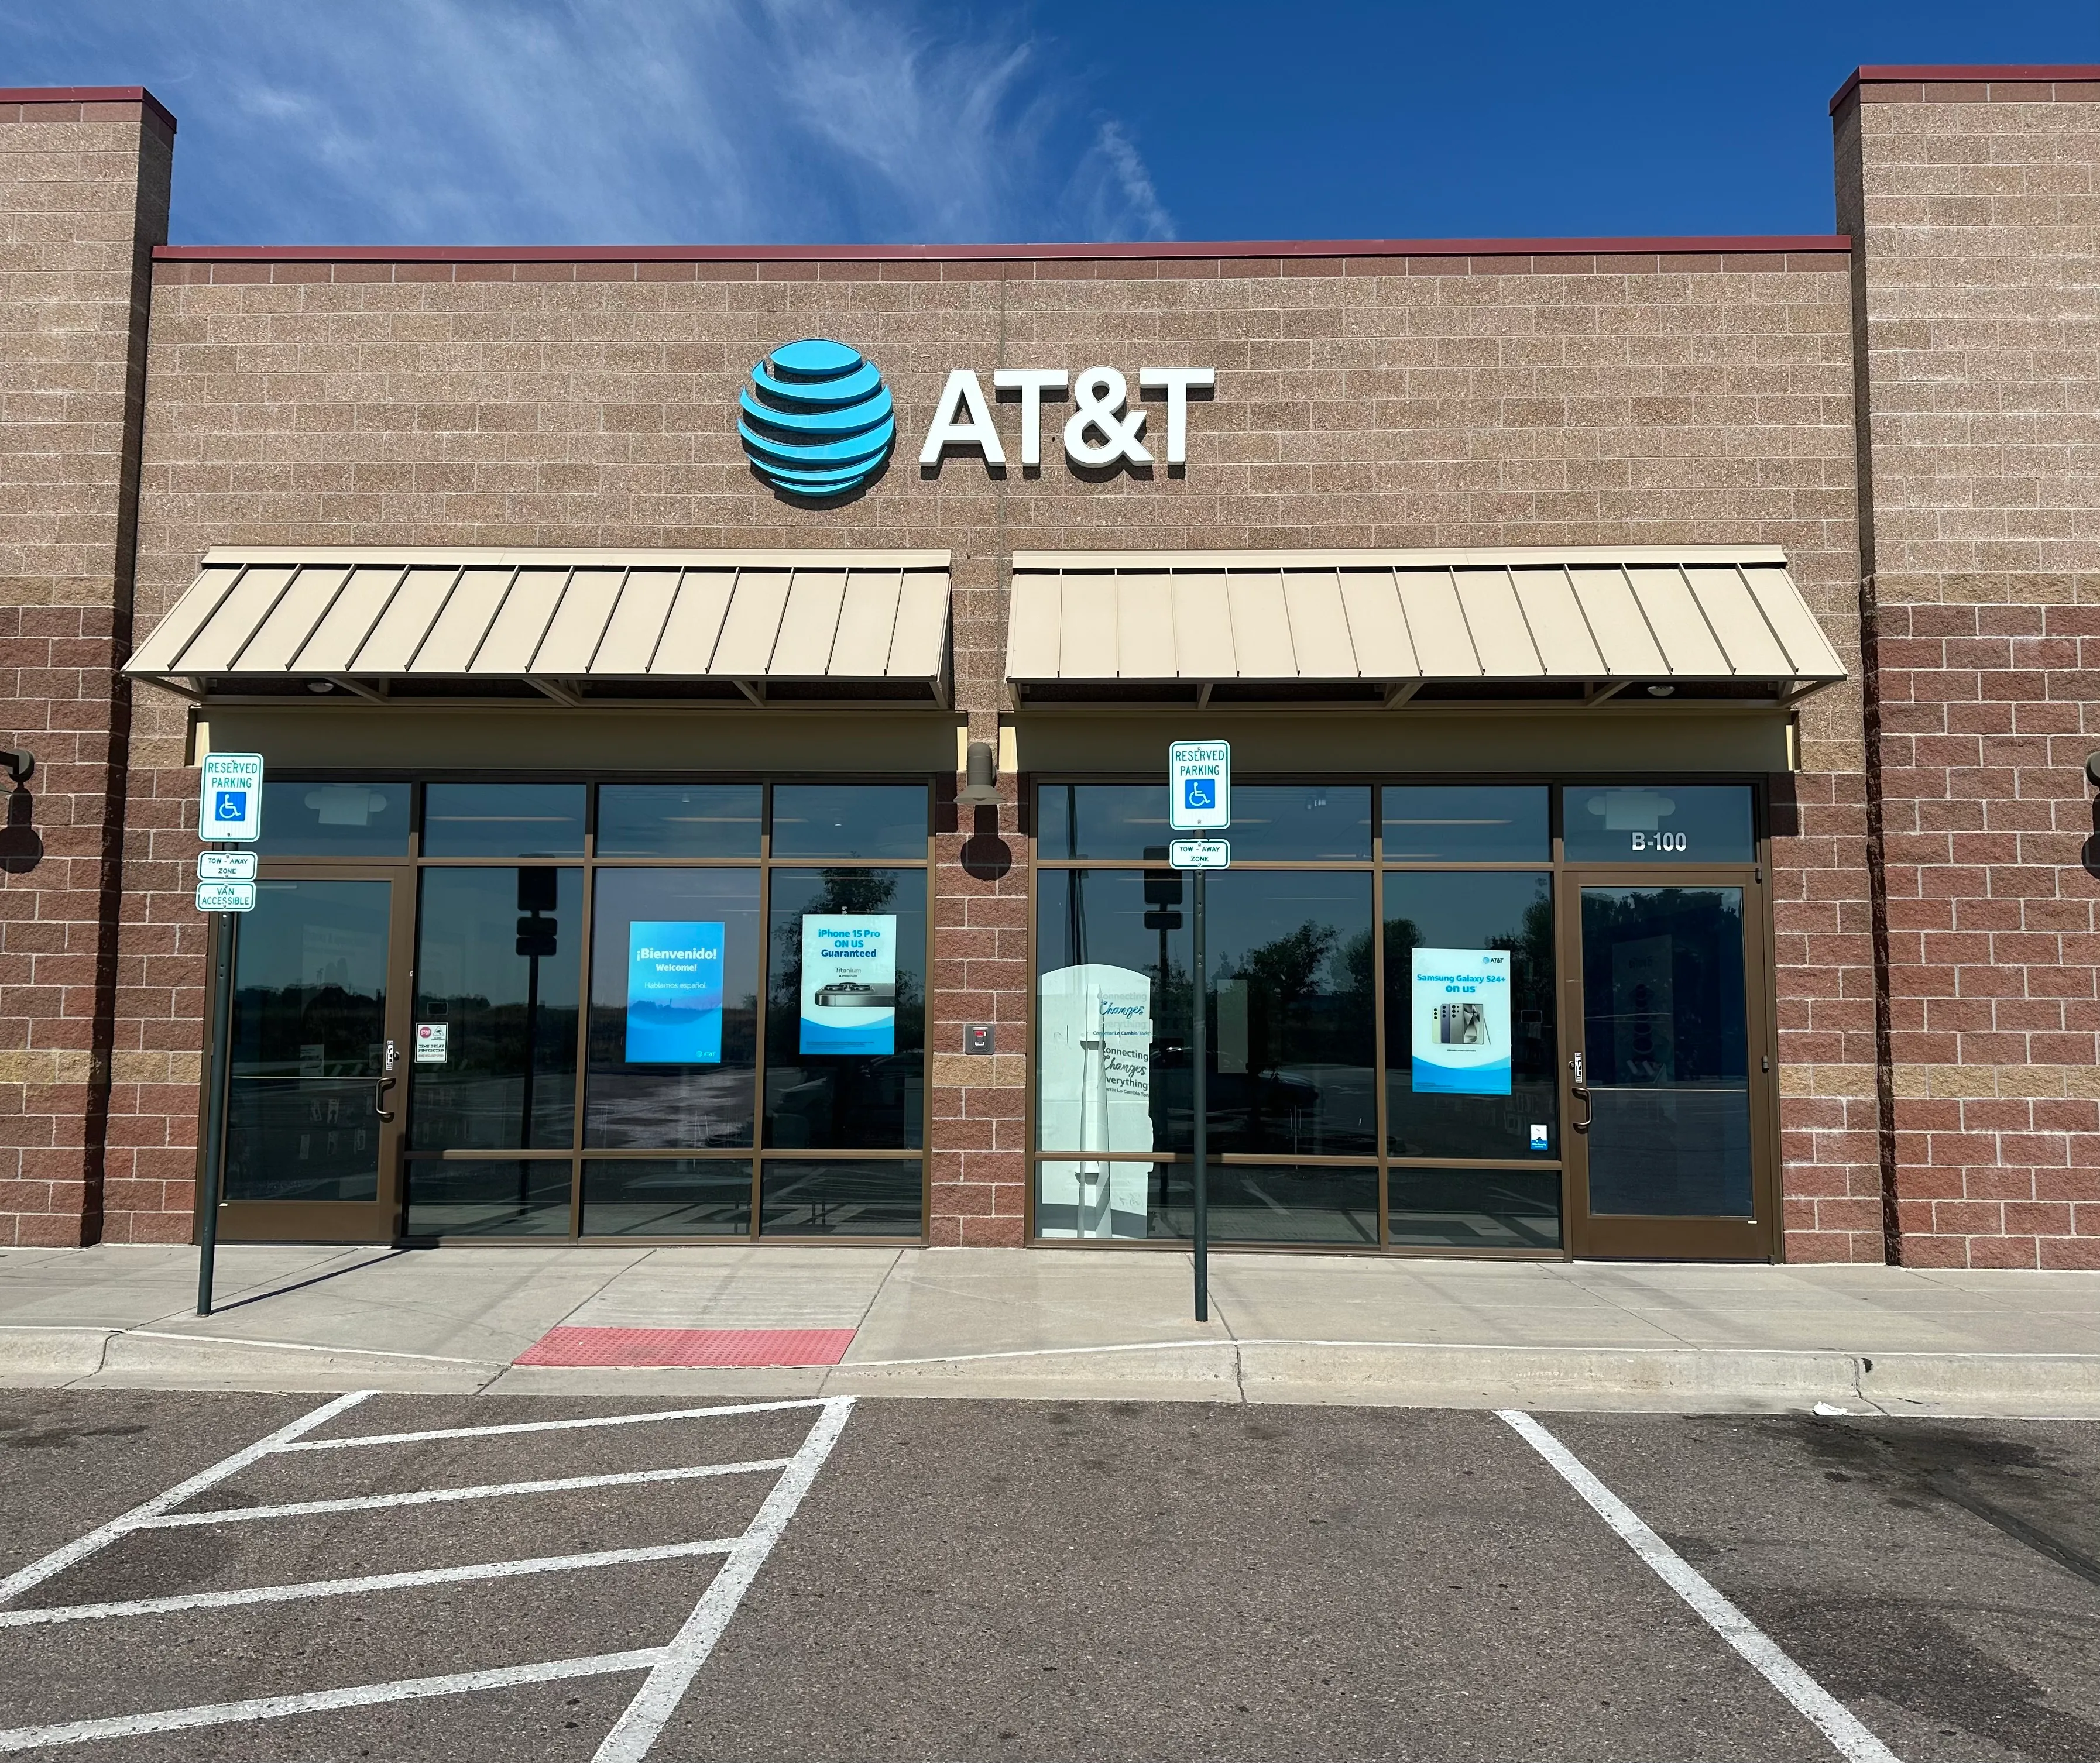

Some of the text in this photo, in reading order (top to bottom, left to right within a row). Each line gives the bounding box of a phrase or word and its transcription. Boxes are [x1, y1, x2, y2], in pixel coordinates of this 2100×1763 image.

[919, 366, 1215, 467] AT&T
[1175, 750, 1224, 761] RESERVED
[208, 762, 258, 773] RESERVED
[1180, 765, 1220, 776] PARKING
[212, 777, 252, 788] PARKING
[1632, 832, 1687, 851] B-100
[217, 887, 235, 895] VAN
[201, 896, 250, 905] ACCESSIBLE
[818, 929, 850, 937] iPhone
[834, 940, 864, 948] ON US
[636, 948, 717, 961] ¡Bienvenido!
[821, 948, 877, 957] Guaranteed
[656, 963, 697, 971] Welcome!
[1417, 974, 1454, 983] Samsung
[1456, 975, 1484, 984] Galaxy
[1099, 1001, 1145, 1019] Changes
[1104, 1047, 1148, 1062] onnecting
[1106, 1077, 1149, 1091] verything
